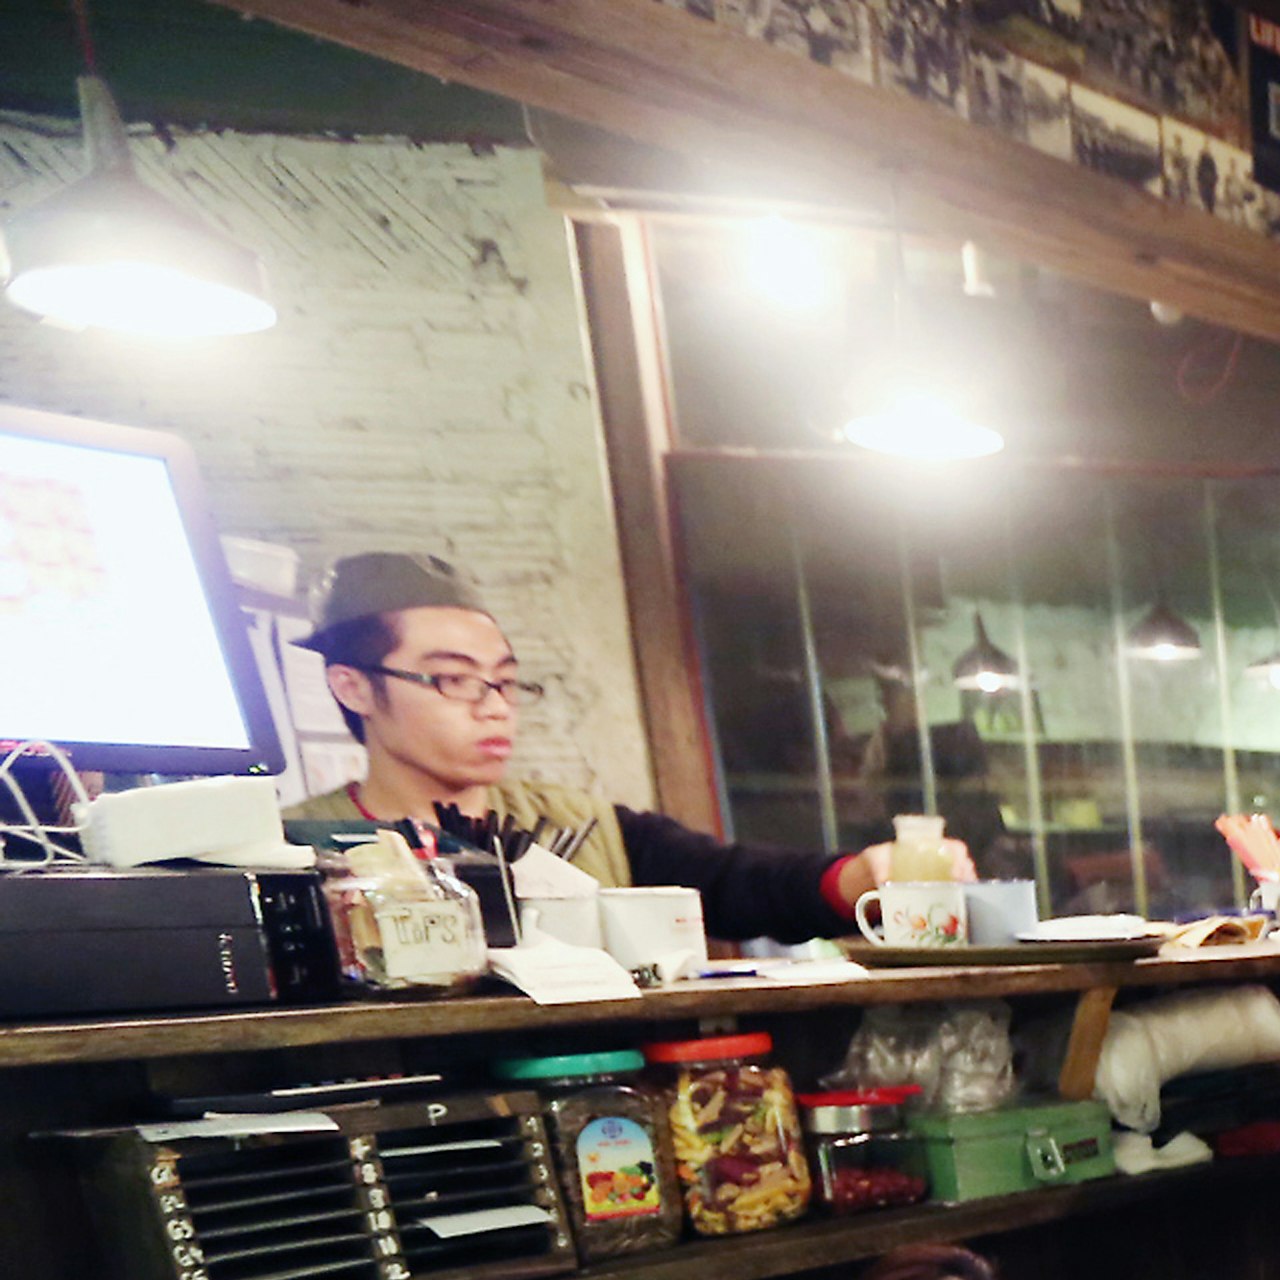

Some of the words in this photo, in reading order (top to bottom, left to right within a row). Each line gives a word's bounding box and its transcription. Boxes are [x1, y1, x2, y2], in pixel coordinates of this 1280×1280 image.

[427, 1103, 447, 1126] P
[532, 1142, 543, 1157] 2
[538, 1163, 549, 1180] 3
[368, 1210, 391, 1232] 10
